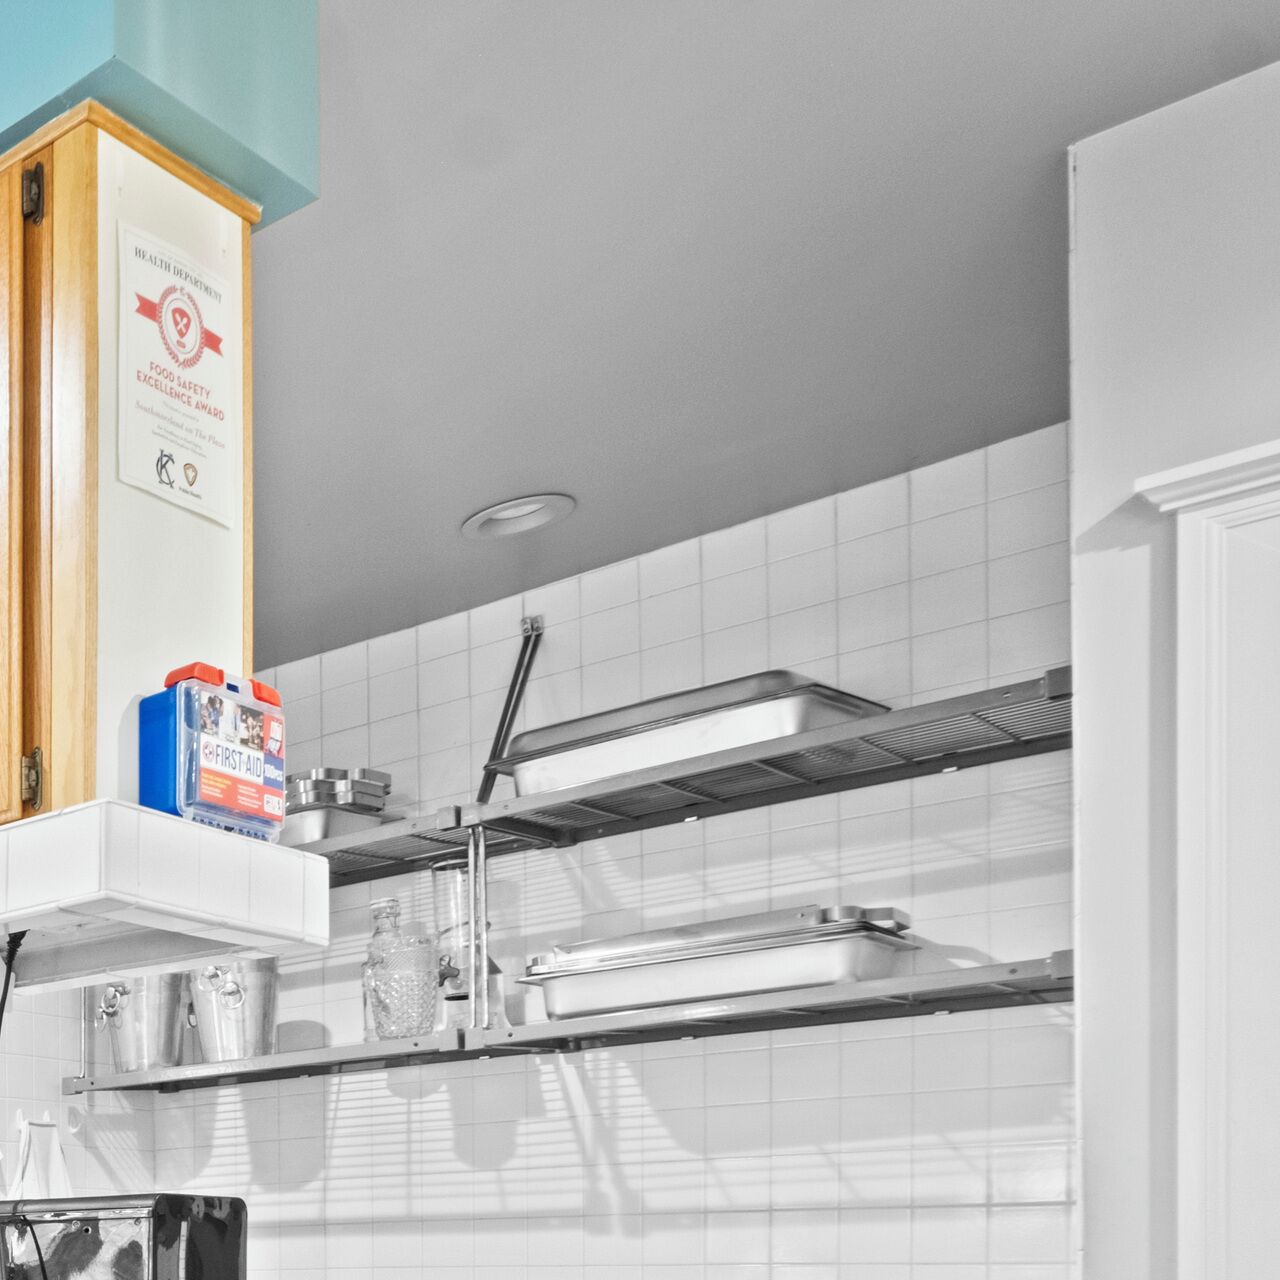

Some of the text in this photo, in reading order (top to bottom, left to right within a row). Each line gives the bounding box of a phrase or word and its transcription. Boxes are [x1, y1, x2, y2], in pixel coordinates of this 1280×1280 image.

[134, 245, 171, 273] HEALTH
[172, 265, 222, 304] DEPARTMENT
[136, 369, 192, 407] EXCELLENCE
[194, 400, 225, 422] AWARD
[149, 361, 211, 400] FOOD SAFETY
[215, 743, 244, 772] FIRST
[245, 754, 263, 778] AID
